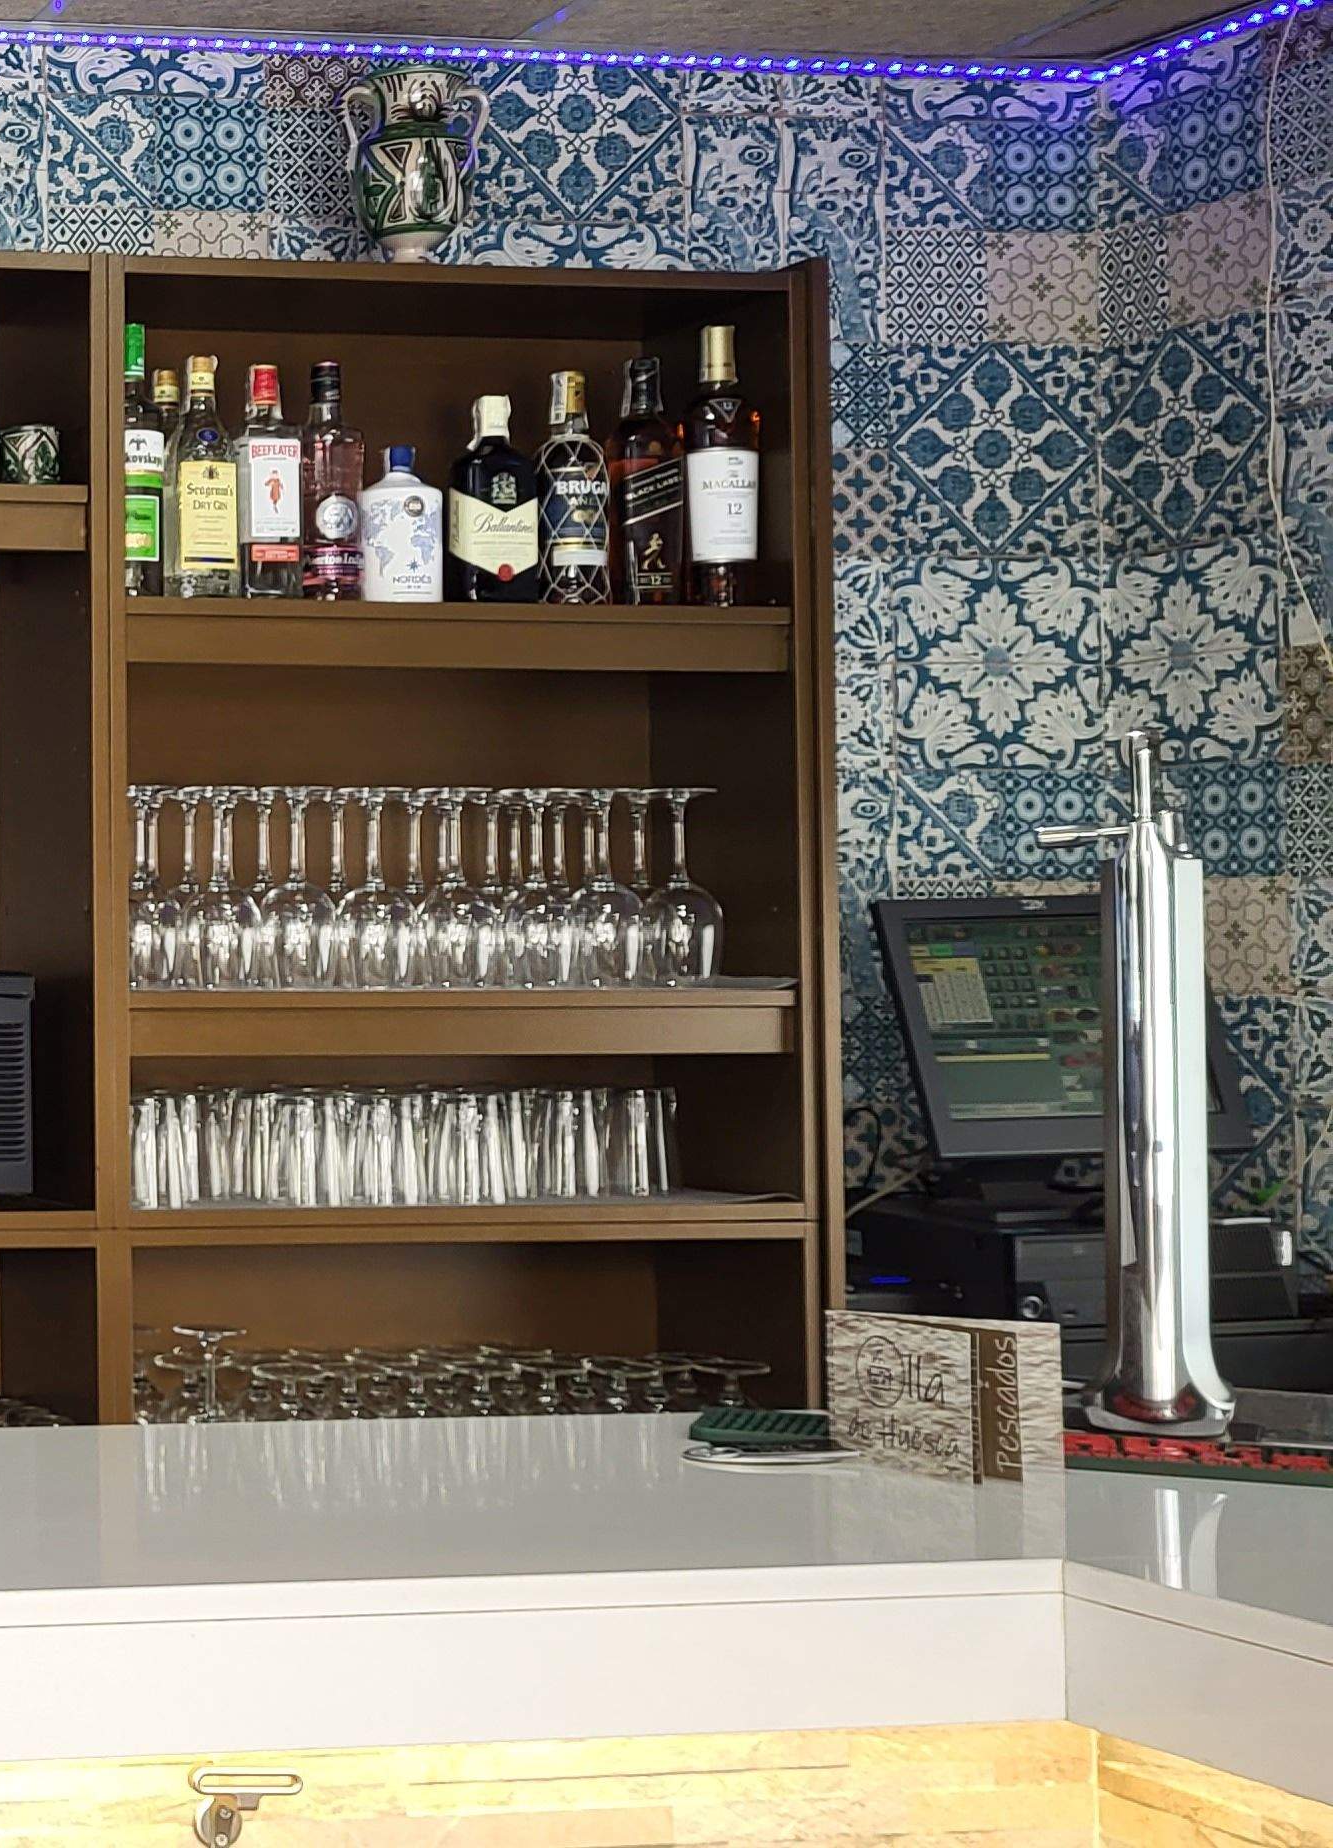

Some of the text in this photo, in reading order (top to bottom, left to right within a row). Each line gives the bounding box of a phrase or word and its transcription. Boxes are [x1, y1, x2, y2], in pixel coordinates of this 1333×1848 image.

[251, 444, 299, 459] BEEFEATER
[727, 502, 743, 515] 12
[985, 1335, 1021, 1472] Pescados
